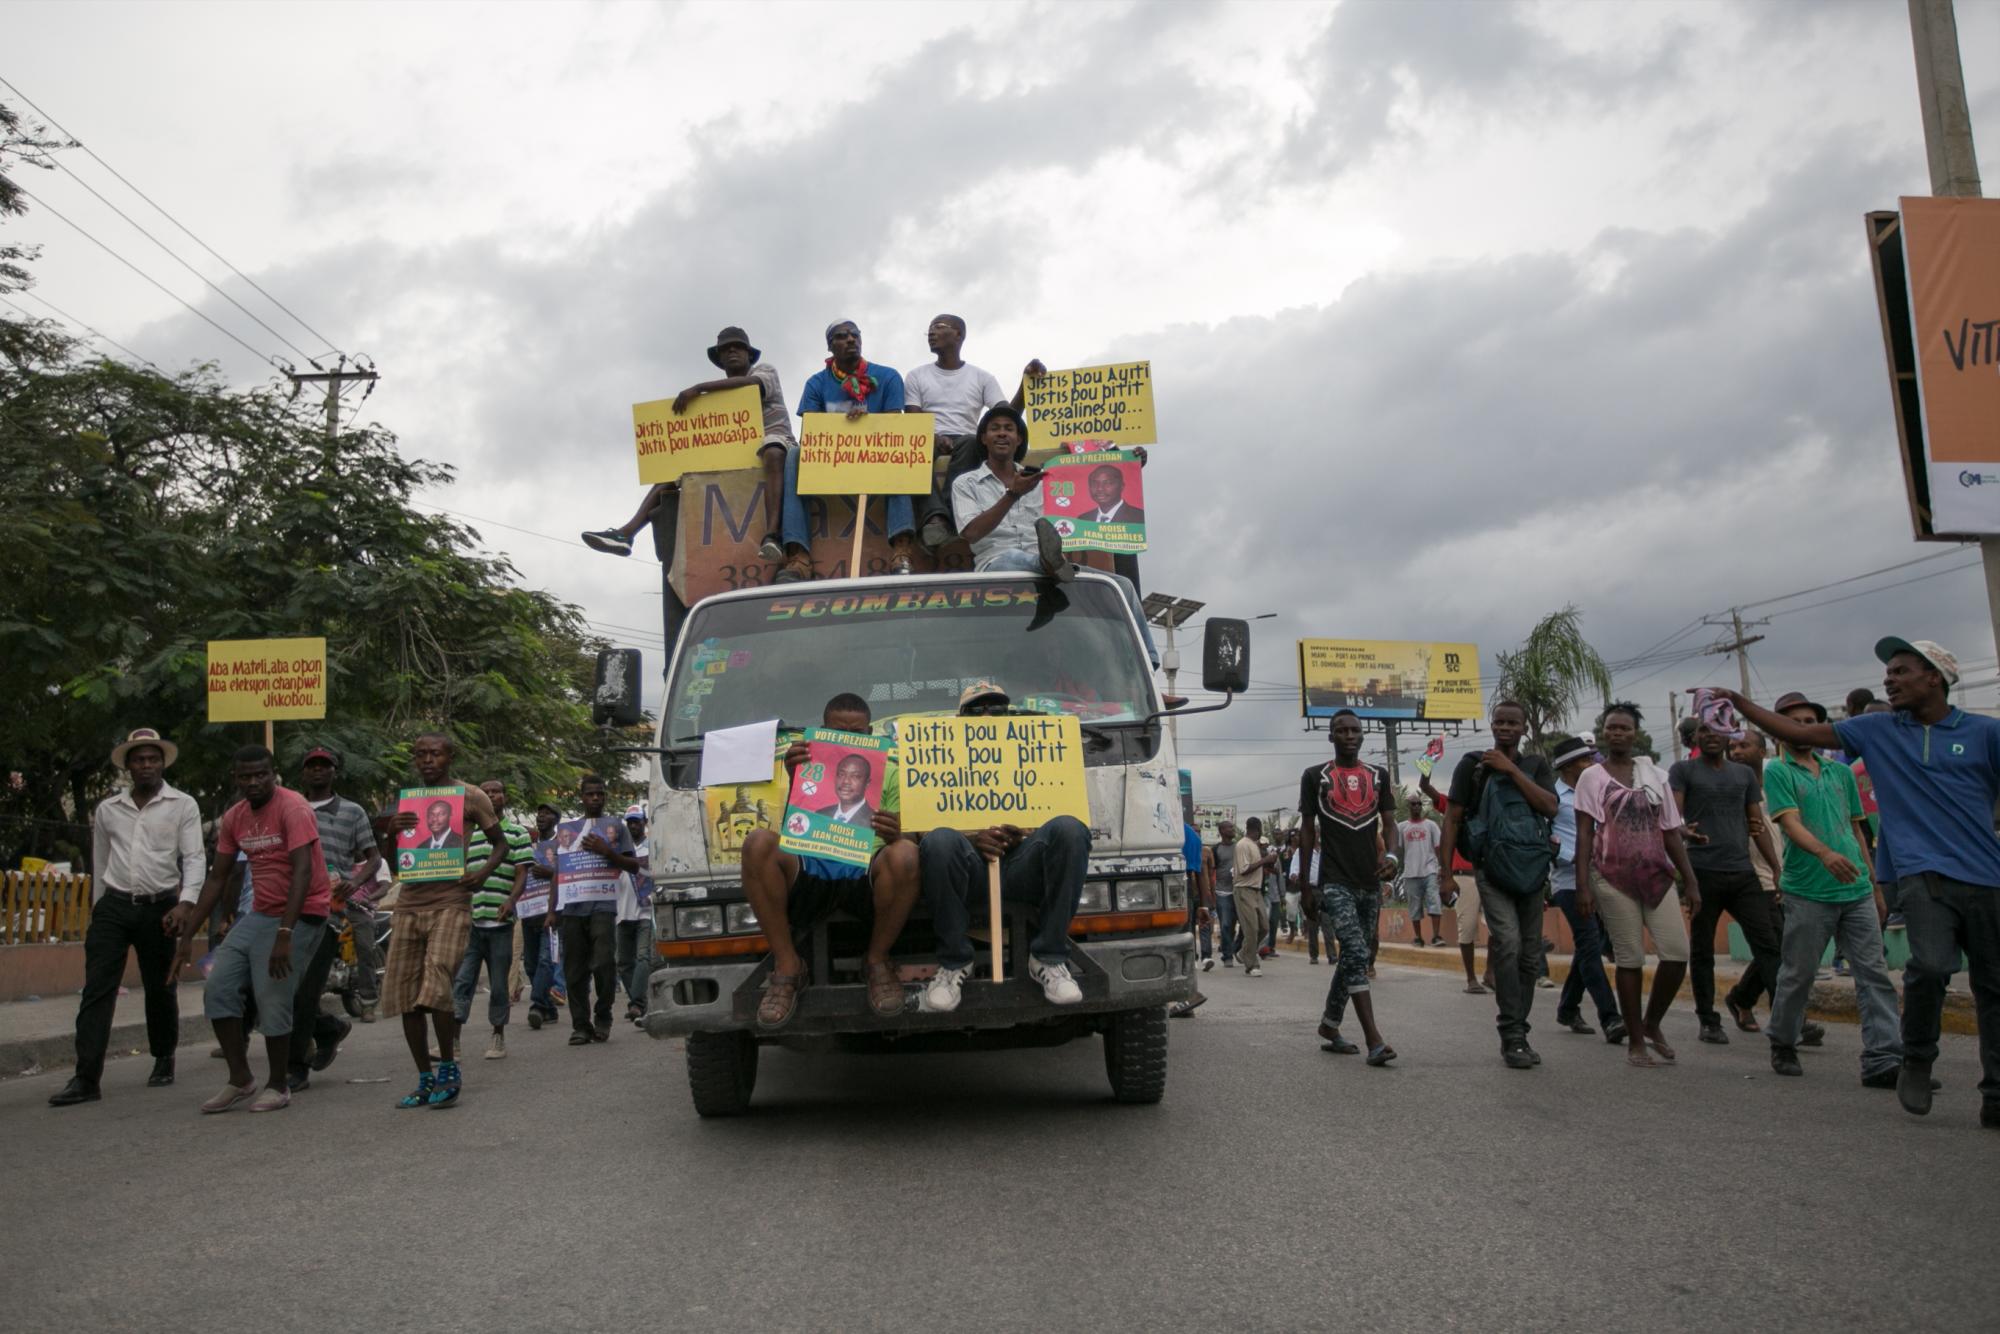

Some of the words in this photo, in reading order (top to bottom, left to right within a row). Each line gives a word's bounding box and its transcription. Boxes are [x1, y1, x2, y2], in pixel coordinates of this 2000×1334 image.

[1028, 374, 1069, 391] Jistis
[1072, 367, 1103, 391] pou
[1107, 364, 1150, 386] Ayiti
[1028, 390, 1069, 407] Jistis
[1071, 387, 1098, 406] pou
[1102, 381, 1145, 405] pitit
[1032, 402, 1106, 423] Dessalines
[636, 420, 664, 439] Jistis
[667, 419, 689, 438] pou
[690, 411, 729, 430] viktim
[733, 410, 750, 428] yo
[638, 438, 667, 456] Jistis
[670, 436, 690, 455] pou
[802, 432, 834, 448] Jistis
[837, 433, 862, 451] pou
[865, 432, 904, 448] viktim
[910, 434, 927, 450] yo
[801, 448, 832, 464] Jistis
[833, 450, 855, 468] pou
[1060, 456, 1080, 464] VOTE
[1104, 532, 1145, 542] CHARLES
[209, 661, 229, 676] Aba
[292, 658, 322, 677] opon
[208, 679, 227, 692] Aba
[1346, 696, 1374, 707] MSC
[815, 730, 837, 742] VOTE
[839, 733, 880, 748] PREZIDAN
[905, 721, 955, 743] Jistis
[965, 723, 997, 748] pou
[1006, 719, 1064, 746] Ayiti
[905, 744, 955, 766] Jistis
[968, 746, 1002, 770] pou
[1018, 740, 1068, 769] pitit
[800, 762, 825, 782] 28
[907, 766, 1000, 788] Dessalines
[829, 823, 856, 836] MOISE
[812, 830, 832, 841] JEAN
[832, 835, 868, 849] CHARLES
[602, 883, 616, 894] 54
